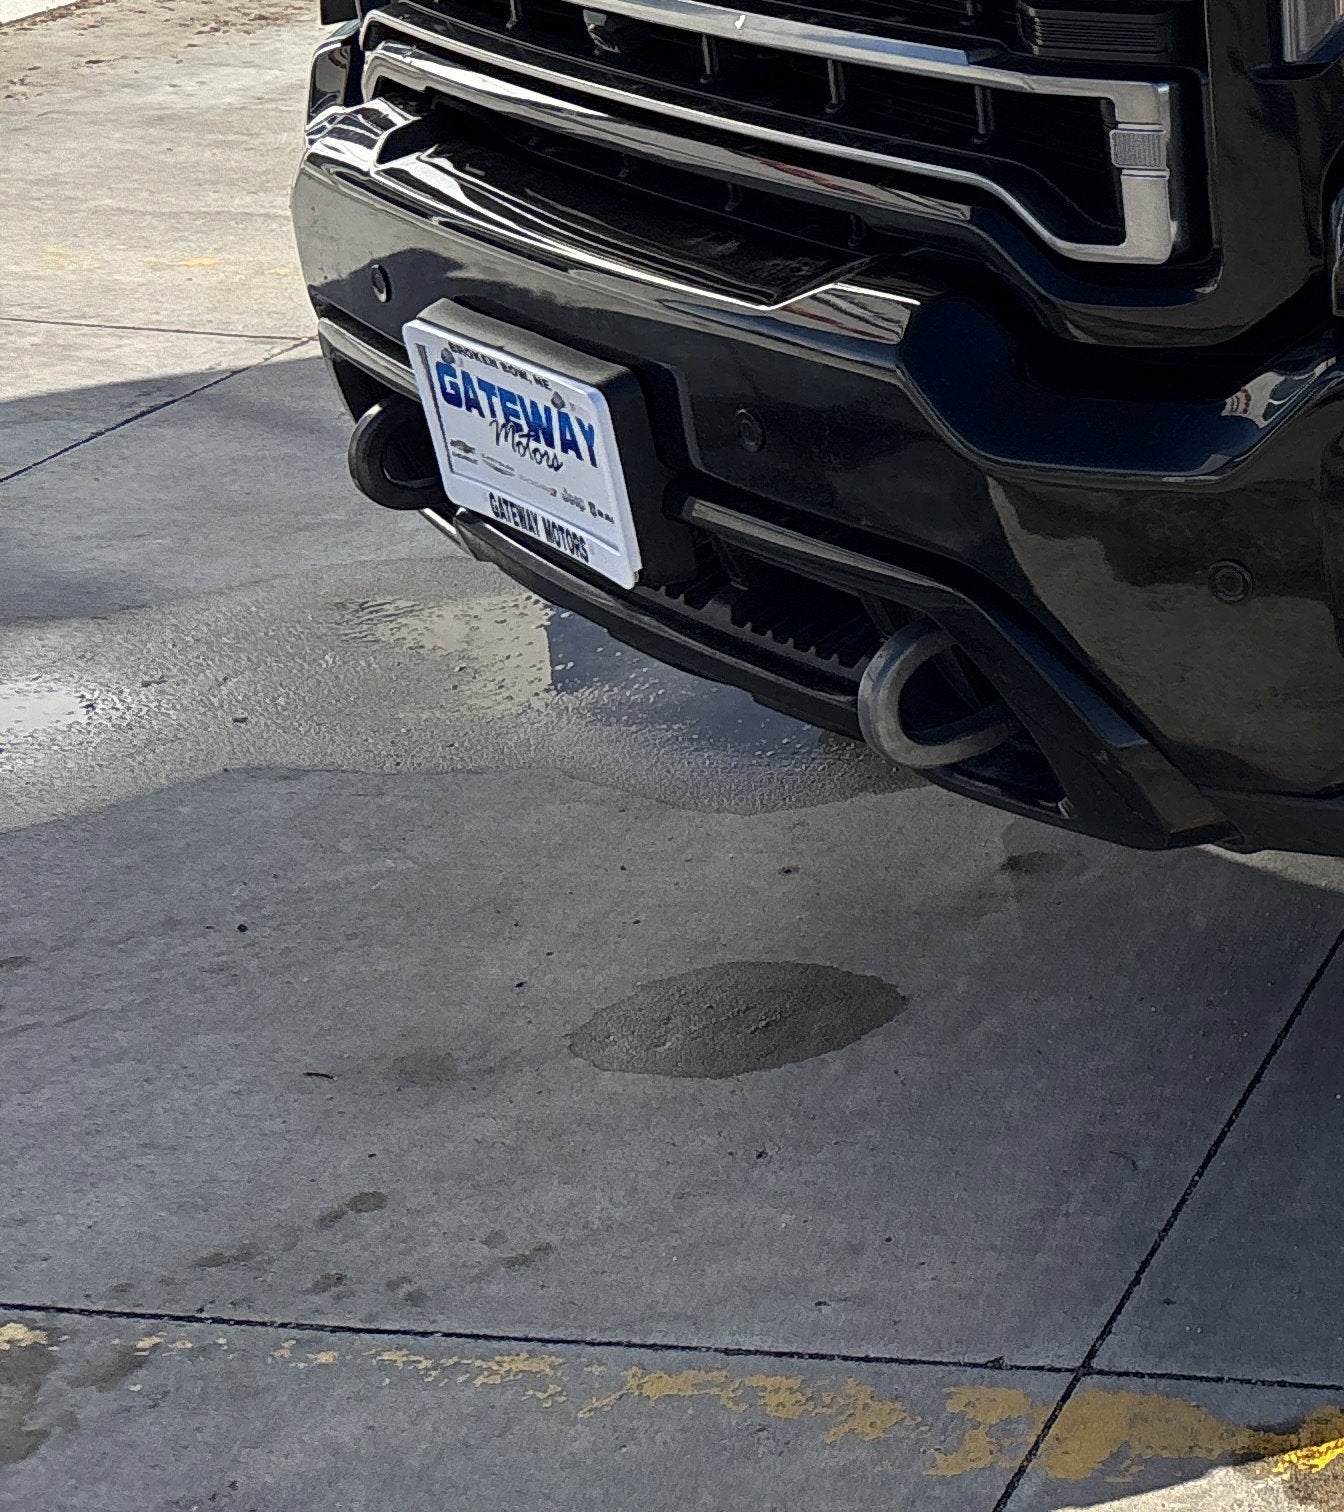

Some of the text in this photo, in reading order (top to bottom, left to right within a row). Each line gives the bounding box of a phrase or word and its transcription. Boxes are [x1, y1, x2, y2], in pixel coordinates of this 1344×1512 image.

[448, 340, 500, 370] BROKEN
[532, 374, 553, 391] NE
[435, 360, 599, 468] GATEWAY
[489, 419, 564, 473] Motors
[488, 491, 541, 537] GATEWAY
[544, 517, 589, 564] MOTORS
